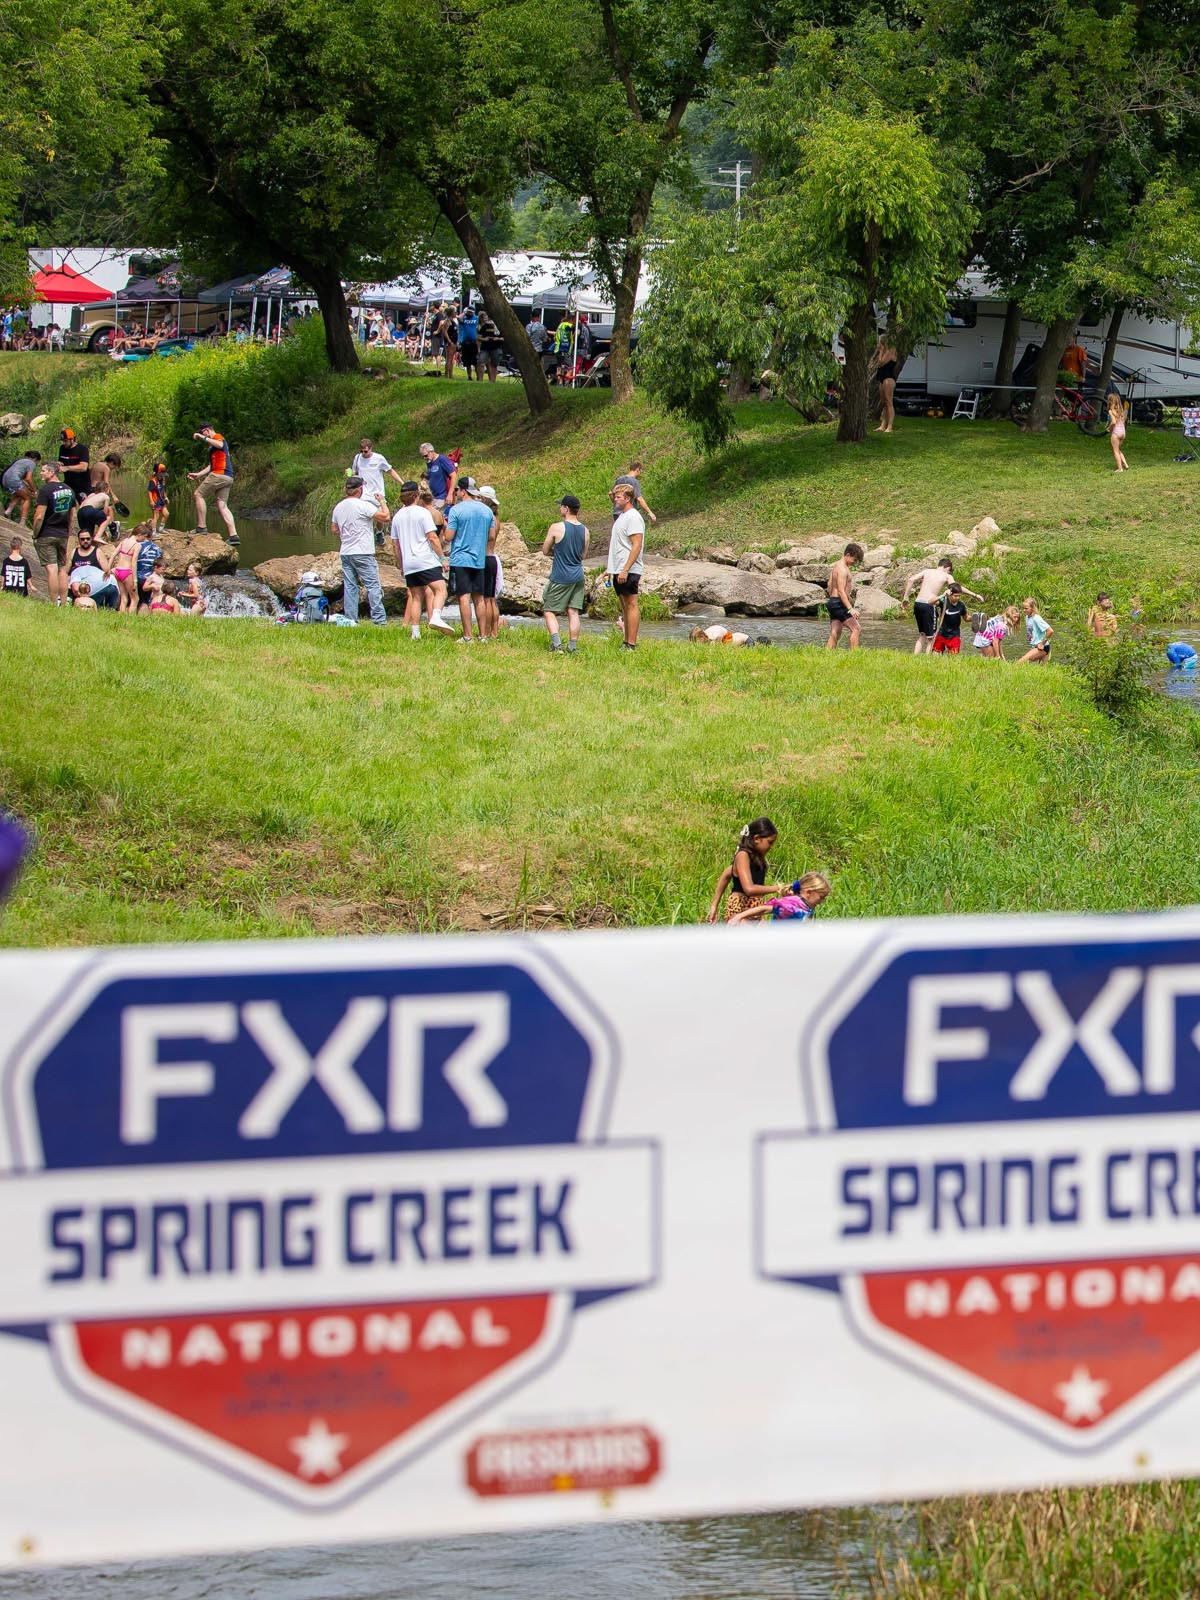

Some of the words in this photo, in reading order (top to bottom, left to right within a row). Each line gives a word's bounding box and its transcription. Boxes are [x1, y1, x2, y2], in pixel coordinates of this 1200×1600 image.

[6, 571, 25, 587] 373
[120, 991, 509, 1144] FXR
[46, 1194, 314, 1286] SPRING
[343, 1177, 575, 1265] CREEK
[838, 1152, 1080, 1240] SPRING
[122, 1308, 509, 1368] NATIONAL
